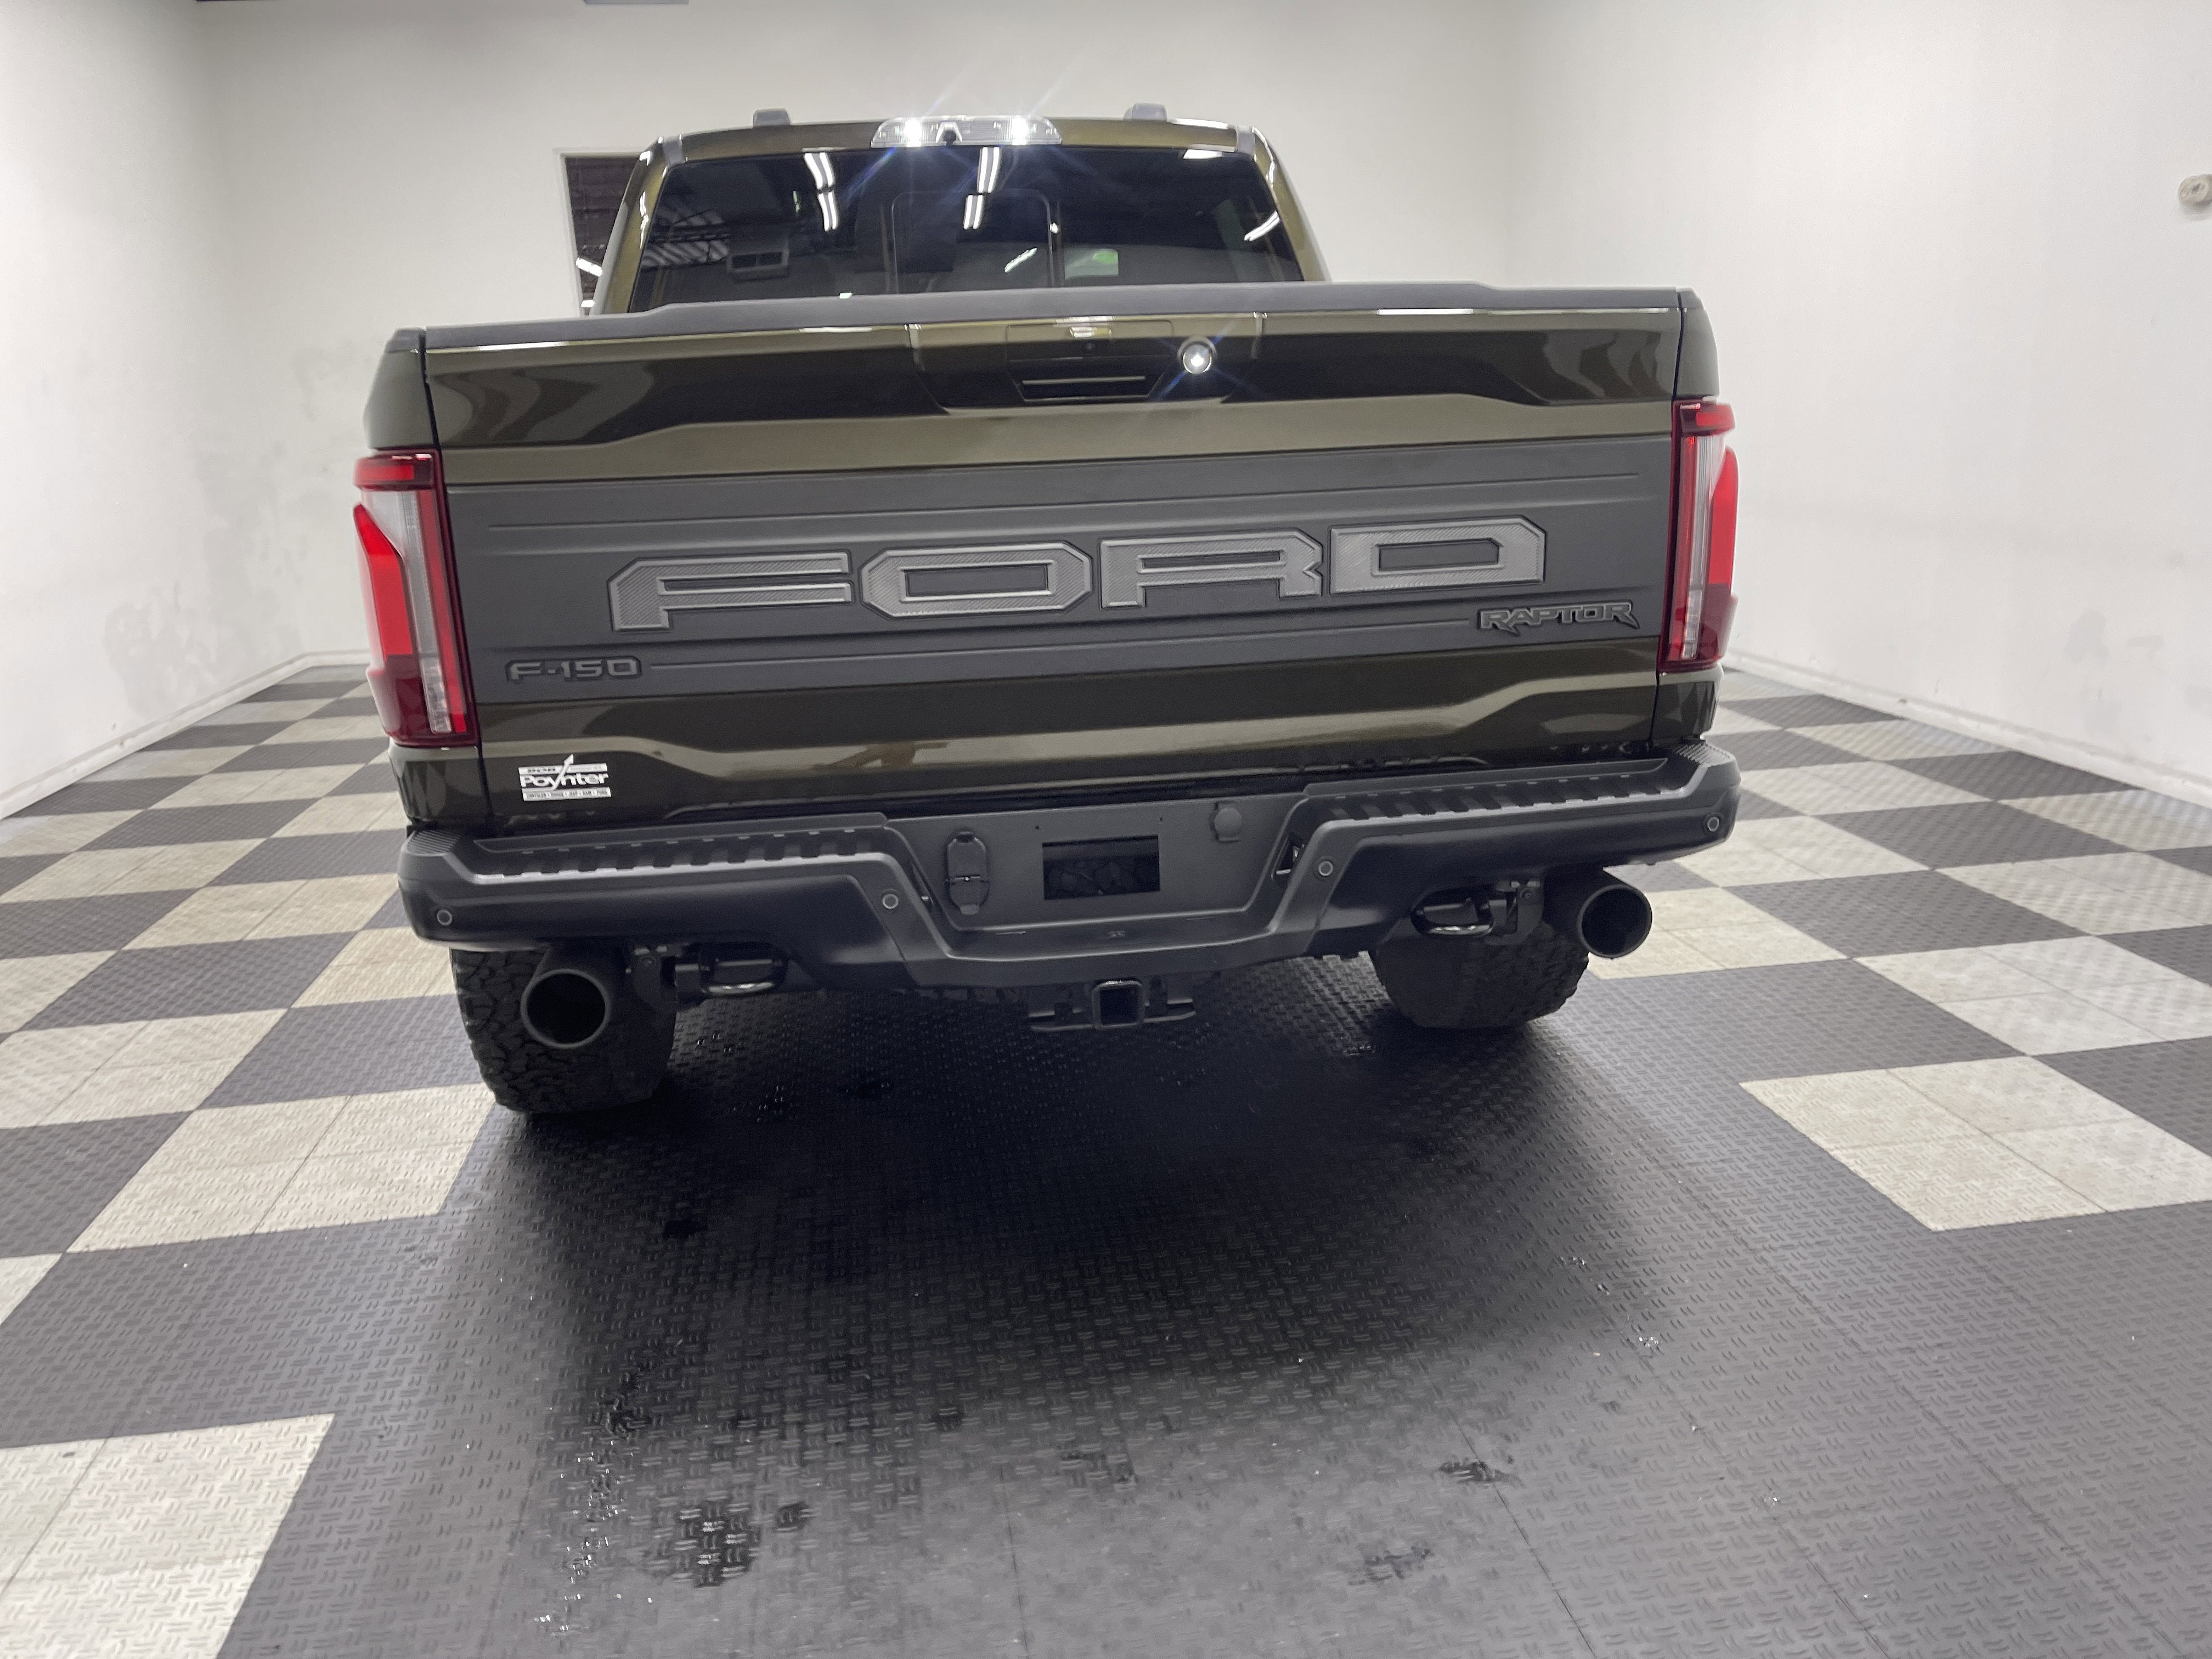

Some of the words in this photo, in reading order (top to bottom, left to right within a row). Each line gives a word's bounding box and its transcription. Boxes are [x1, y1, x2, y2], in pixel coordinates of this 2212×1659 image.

[608, 516, 1546, 631] FORD
[1480, 601, 1640, 635] RAPTOR
[507, 657, 640, 681] F-150
[520, 771, 609, 789] Poynter
